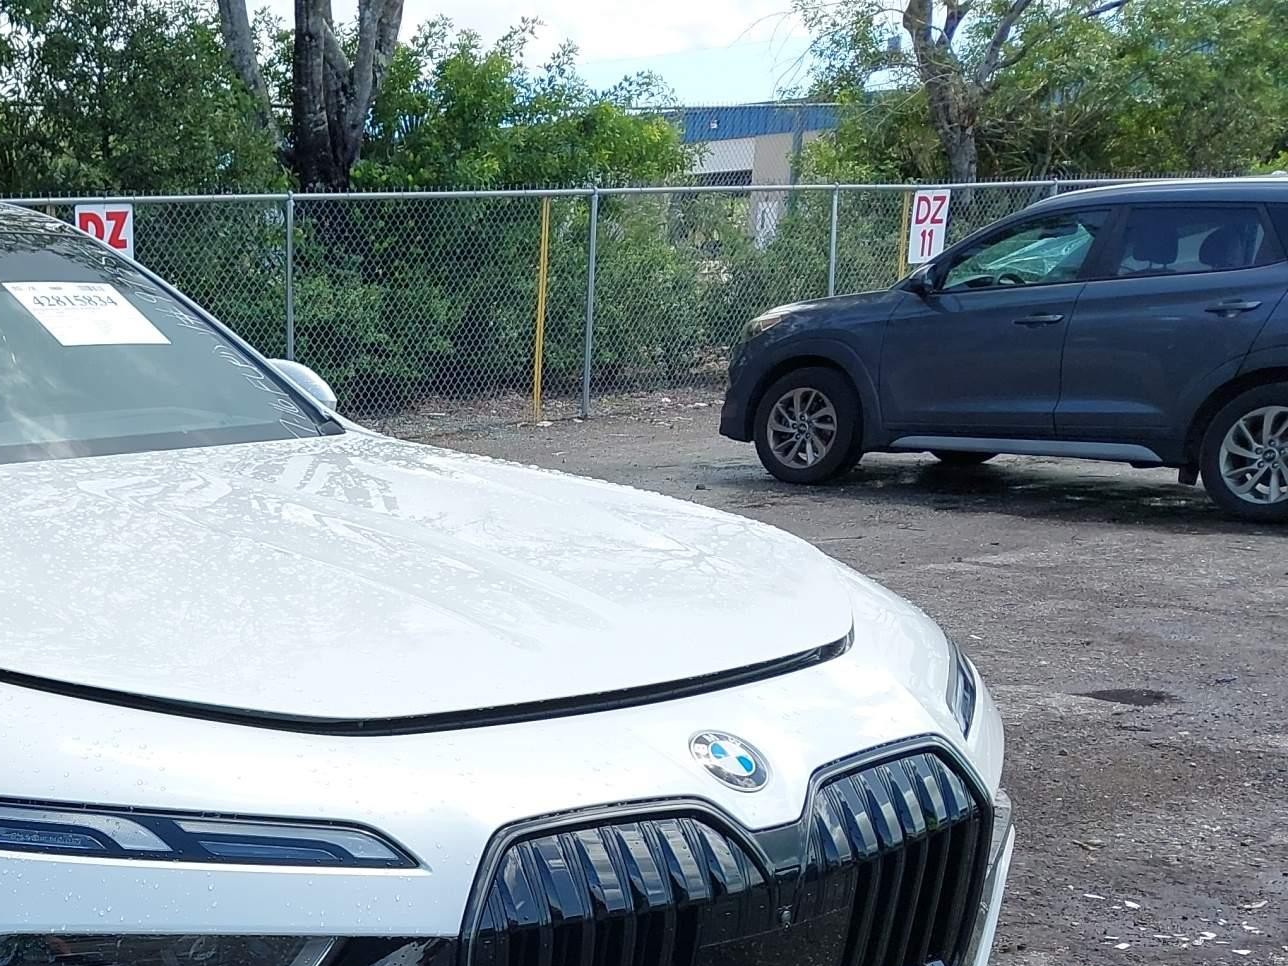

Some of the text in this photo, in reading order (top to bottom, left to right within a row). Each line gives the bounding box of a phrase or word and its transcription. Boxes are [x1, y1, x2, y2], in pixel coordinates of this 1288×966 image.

[915, 196, 946, 224] DZ
[79, 211, 128, 249] DZ
[920, 229, 933, 256] 11
[33, 295, 119, 308] 42815834
